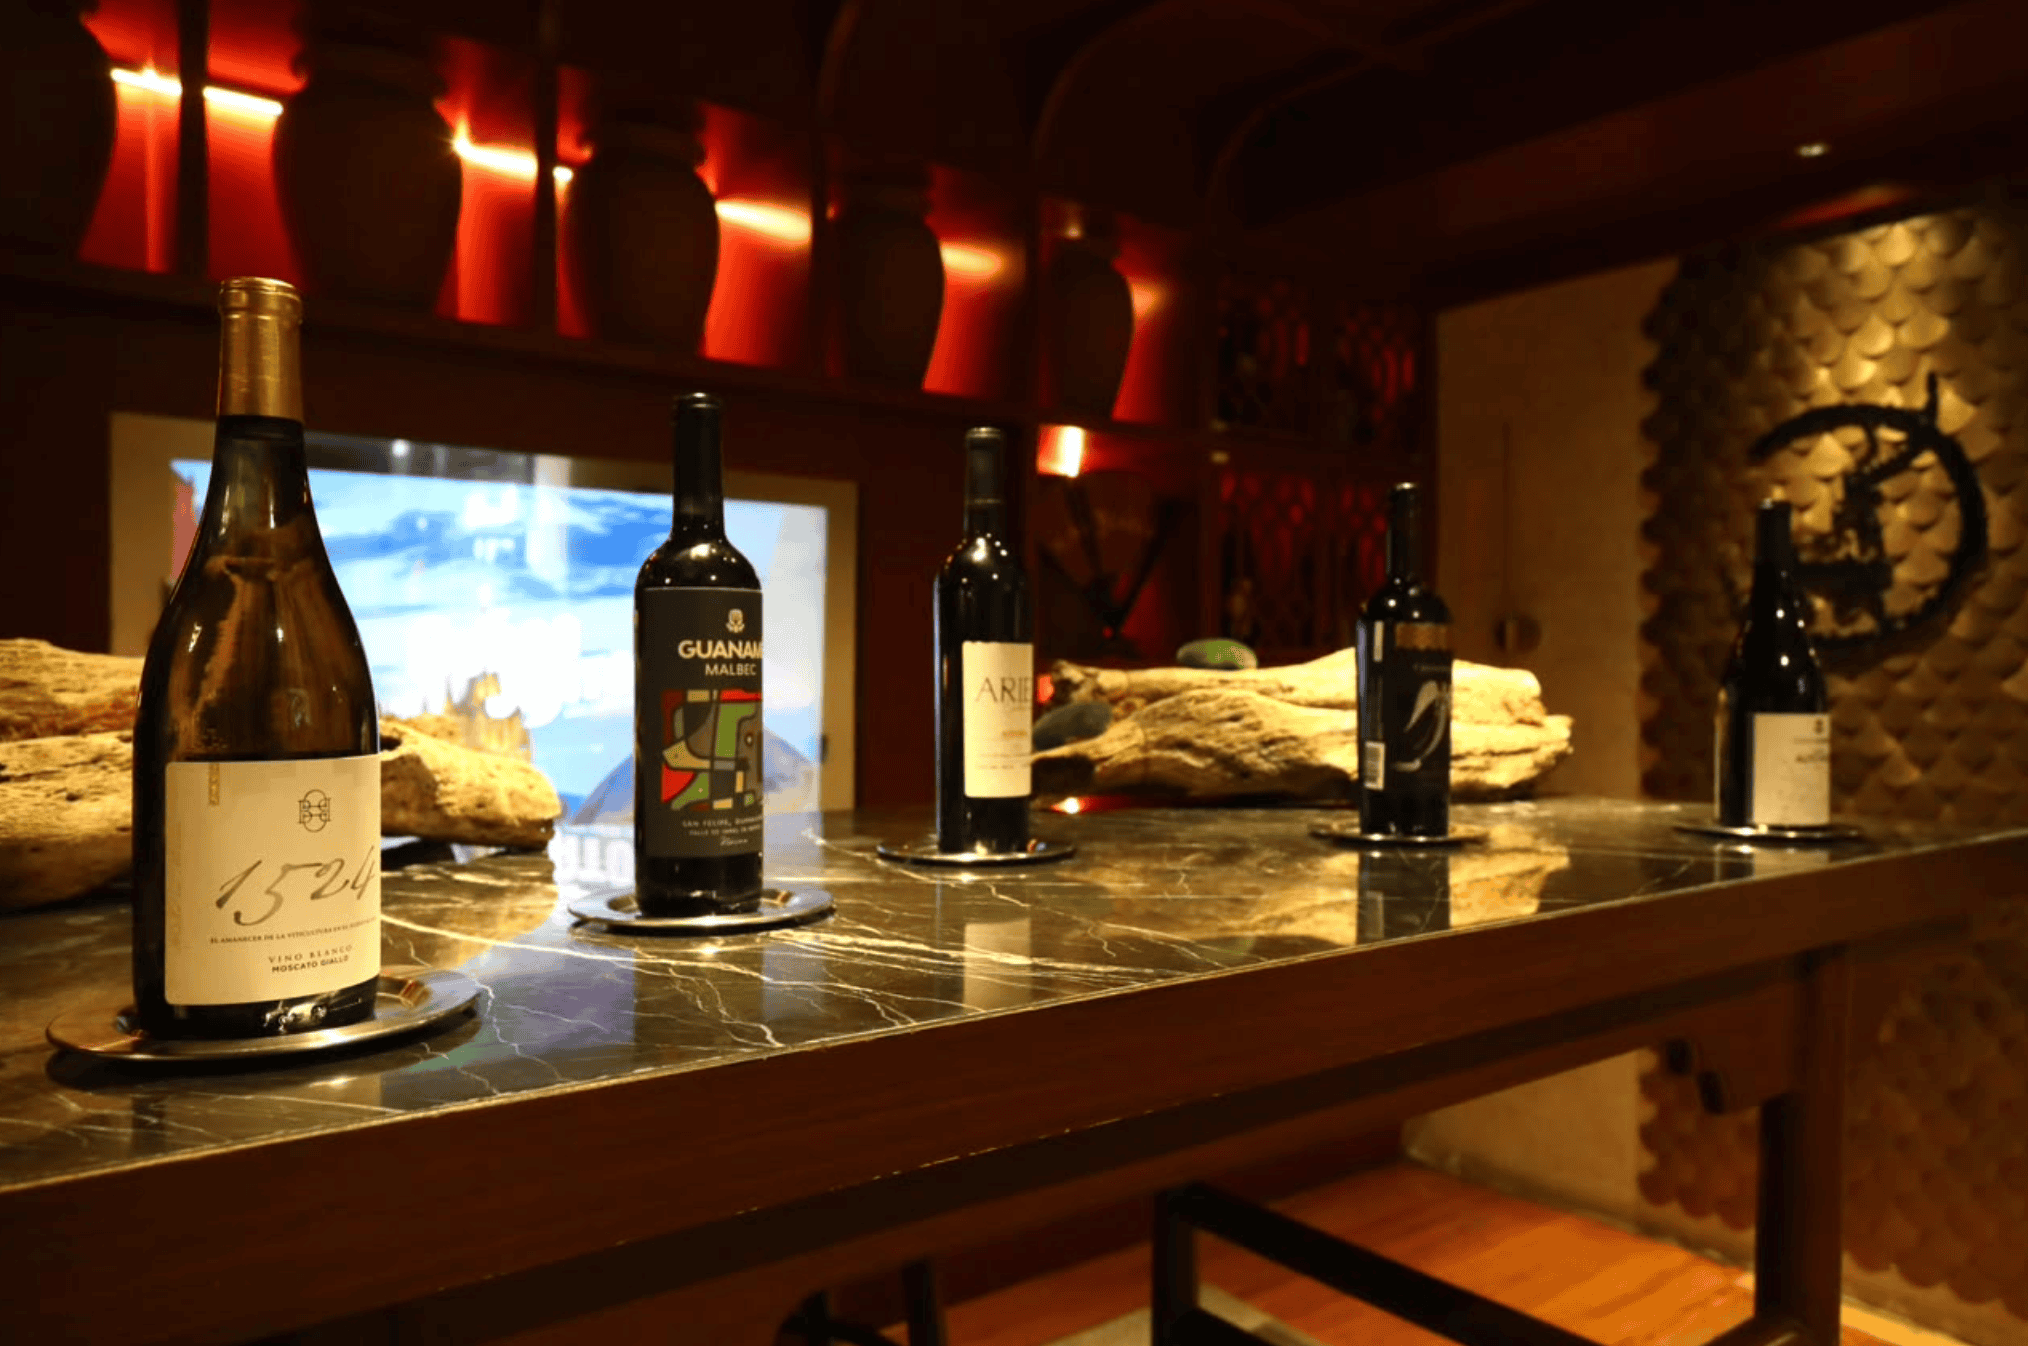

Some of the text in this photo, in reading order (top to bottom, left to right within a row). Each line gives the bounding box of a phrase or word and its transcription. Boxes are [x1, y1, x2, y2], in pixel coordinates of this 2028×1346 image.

[705, 662, 758, 677] MALBEC
[215, 845, 376, 927] 1524
[263, 933, 274, 941] DE
[267, 944, 353, 964] VINO BLANCO
[271, 954, 350, 974] MOSCATO GIALLO
